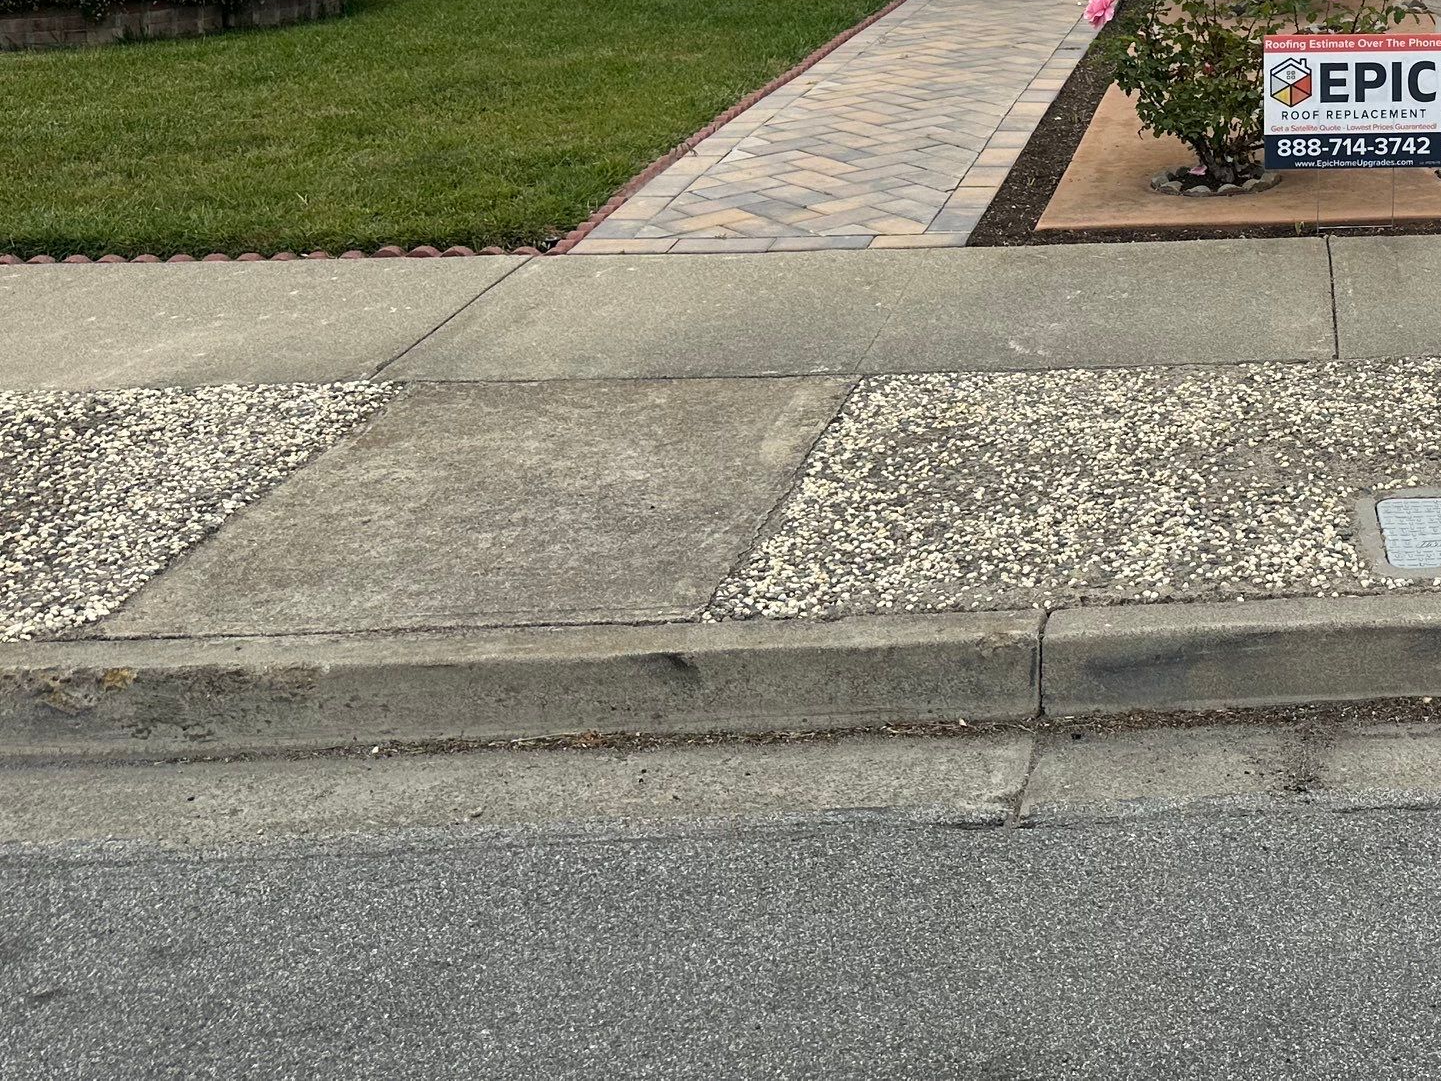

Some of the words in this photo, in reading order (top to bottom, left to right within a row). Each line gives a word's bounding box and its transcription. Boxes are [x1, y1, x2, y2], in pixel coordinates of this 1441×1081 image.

[1265, 40, 1306, 51] Roofing
[1309, 39, 1355, 49] Estimate
[1357, 38, 1383, 48] Over
[1386, 38, 1406, 48] The
[1320, 60, 1437, 103] EPIC
[1281, 110, 1320, 120] ROOF
[1326, 108, 1427, 119] REPLACEMENT
[1290, 124, 1318, 132] Satellite
[1319, 124, 1342, 132] Quote
[1372, 123, 1394, 131] Prices
[1277, 136, 1431, 157] 888-714-3742
[1294, 159, 1414, 168] www.EpicHomeUpgrades.com
